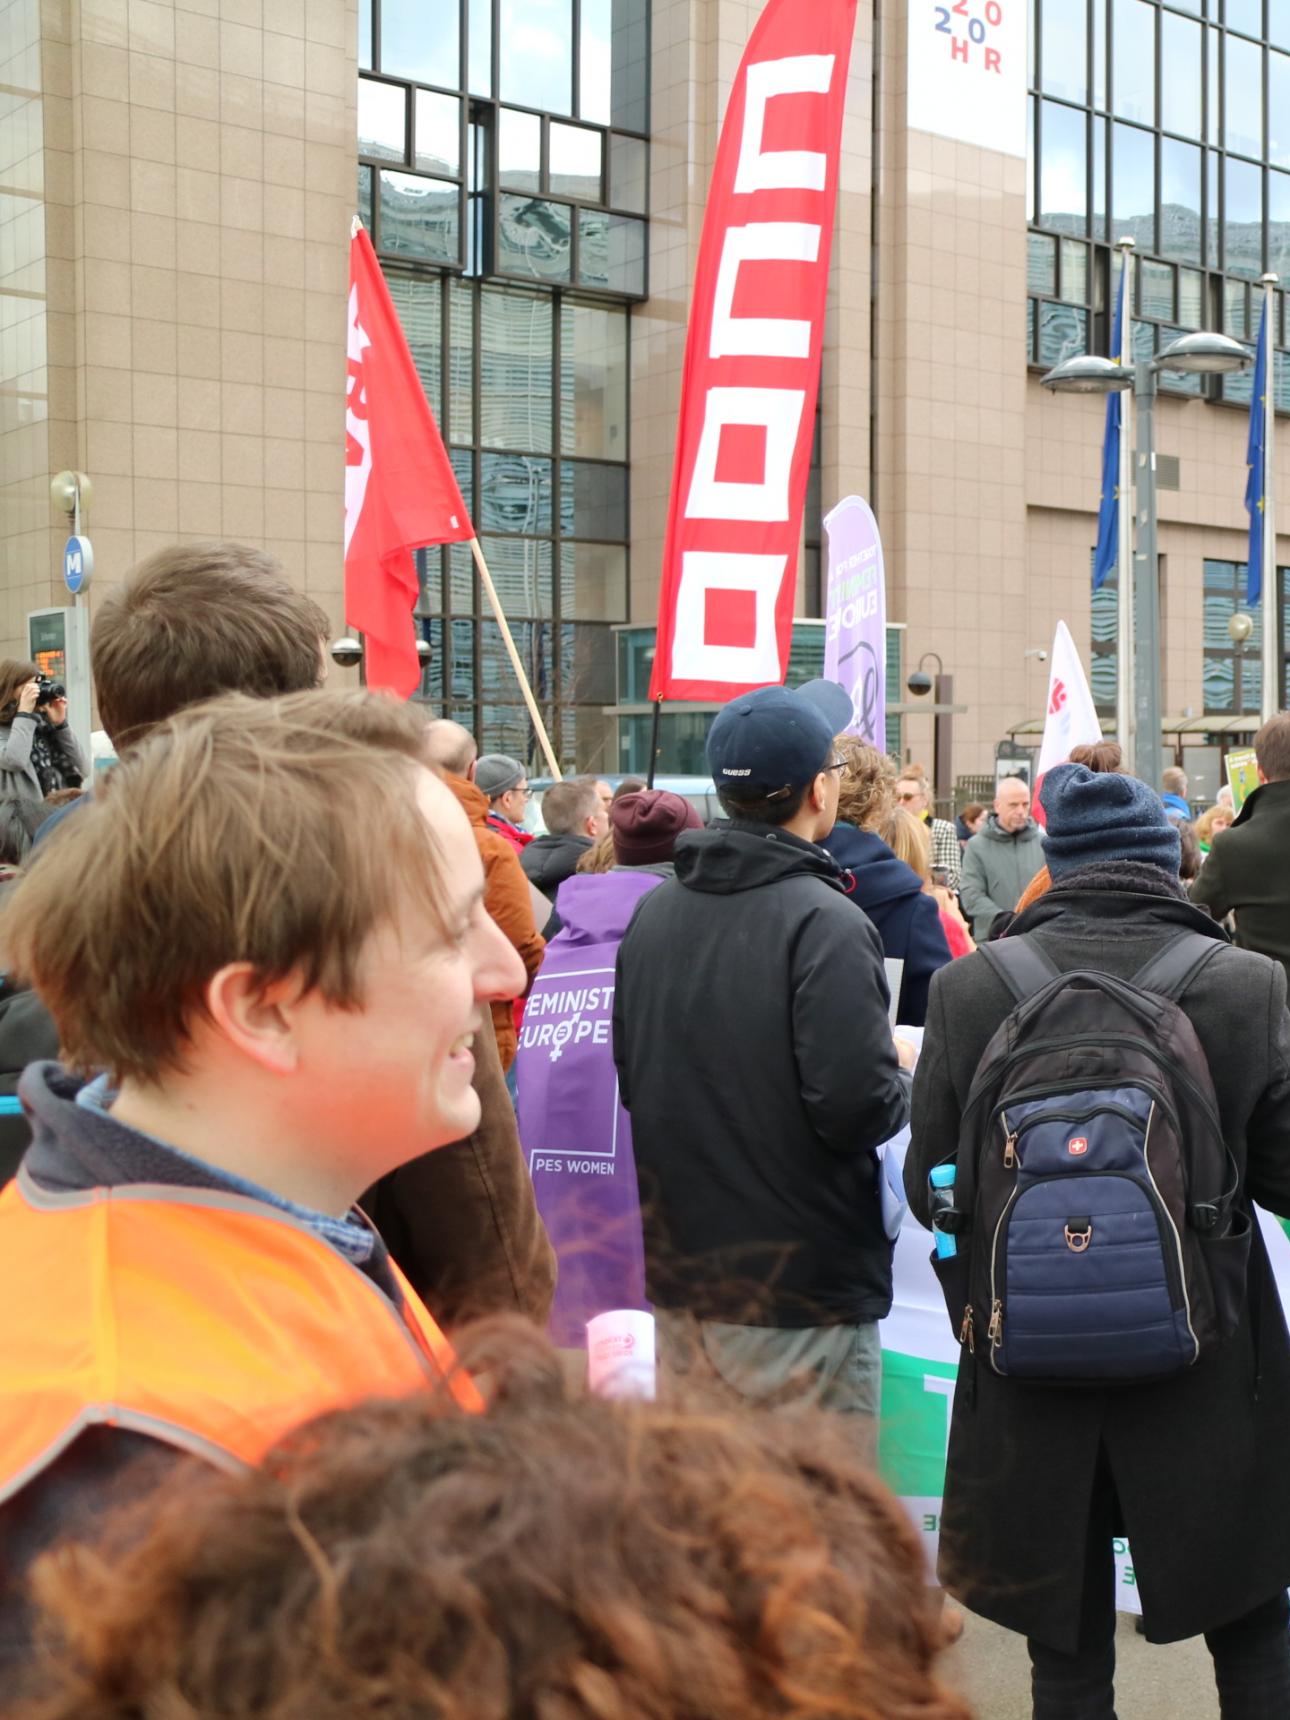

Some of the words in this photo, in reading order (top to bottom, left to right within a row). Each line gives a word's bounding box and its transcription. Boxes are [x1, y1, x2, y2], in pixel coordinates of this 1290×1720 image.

[66, 554, 81, 576] M
[536, 1158, 562, 1172] PES
[567, 1160, 615, 1175] WOMEN
